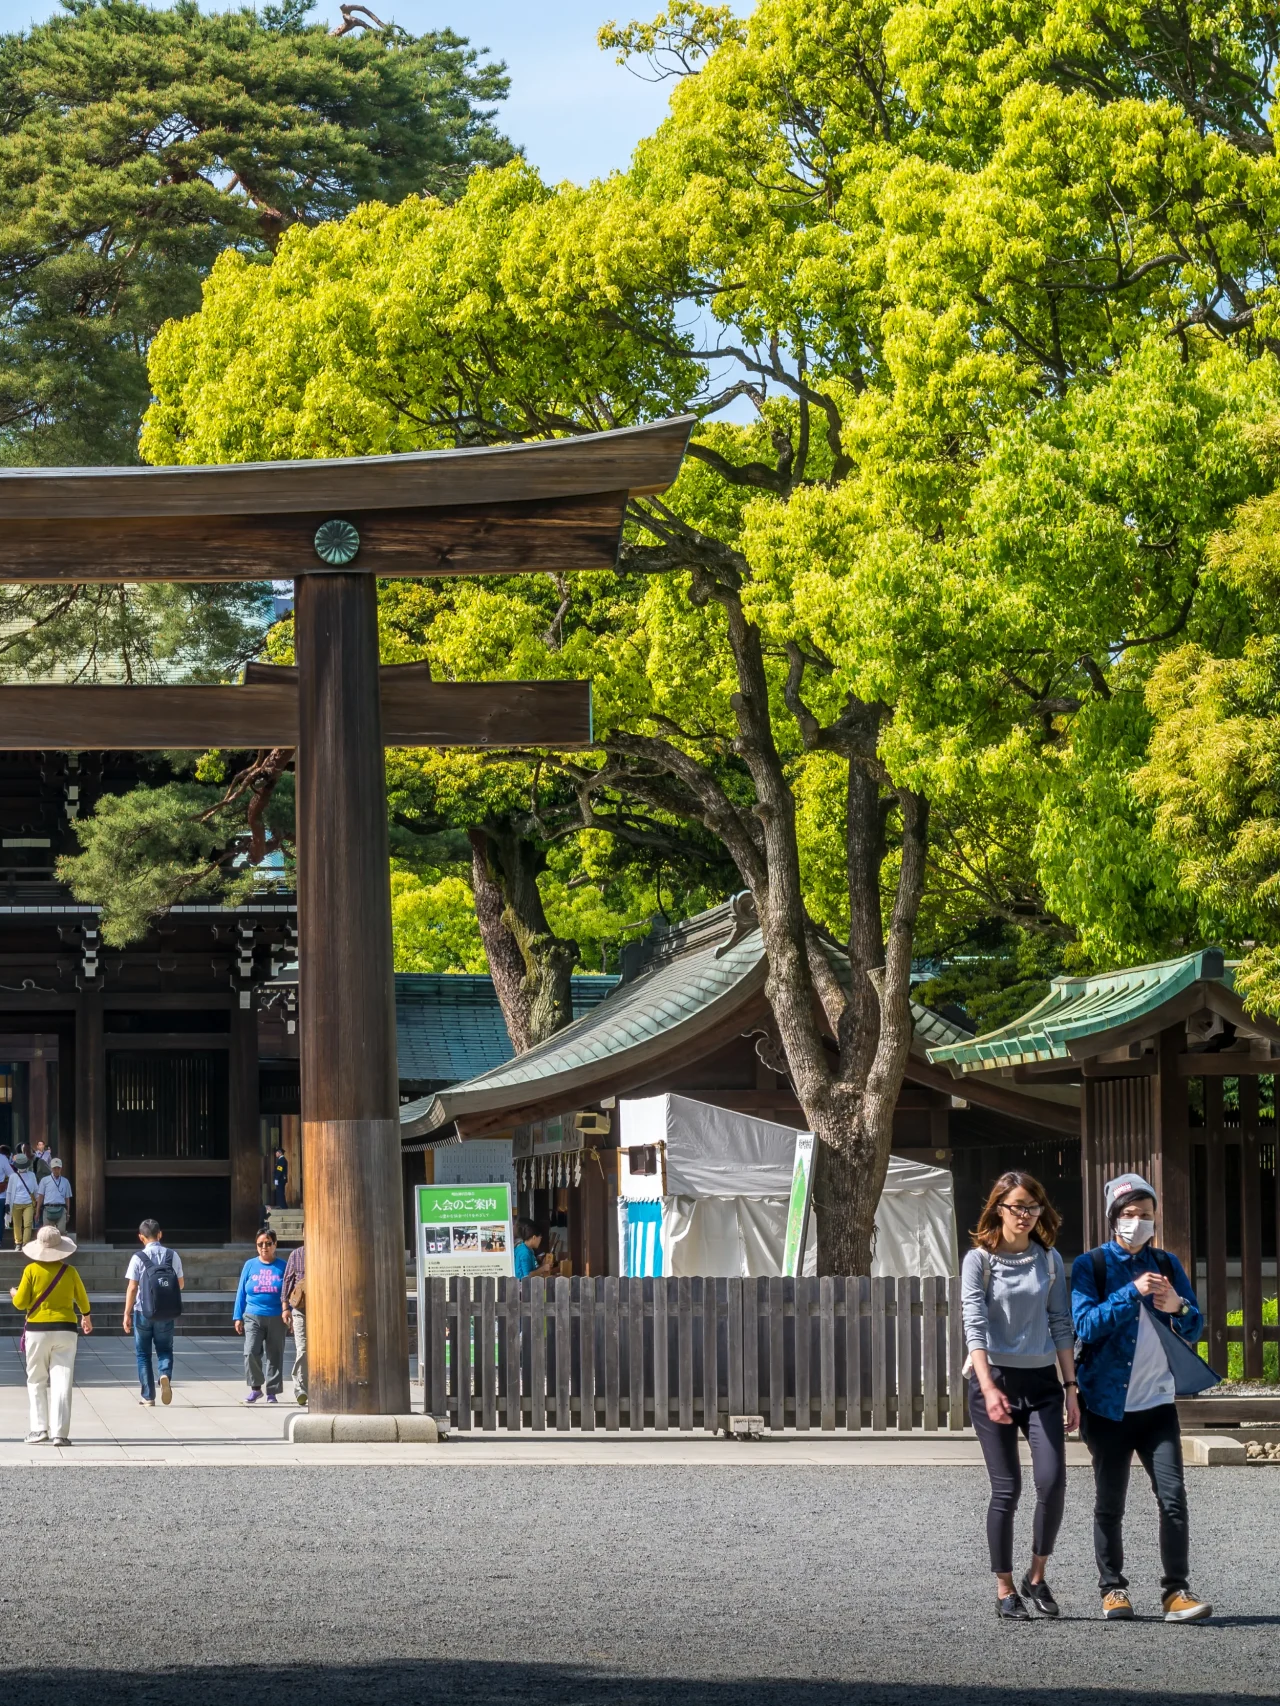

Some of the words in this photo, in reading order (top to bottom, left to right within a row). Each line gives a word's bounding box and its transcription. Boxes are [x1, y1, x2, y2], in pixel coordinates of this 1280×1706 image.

[431, 1198, 497, 1211] 入会のご案内
